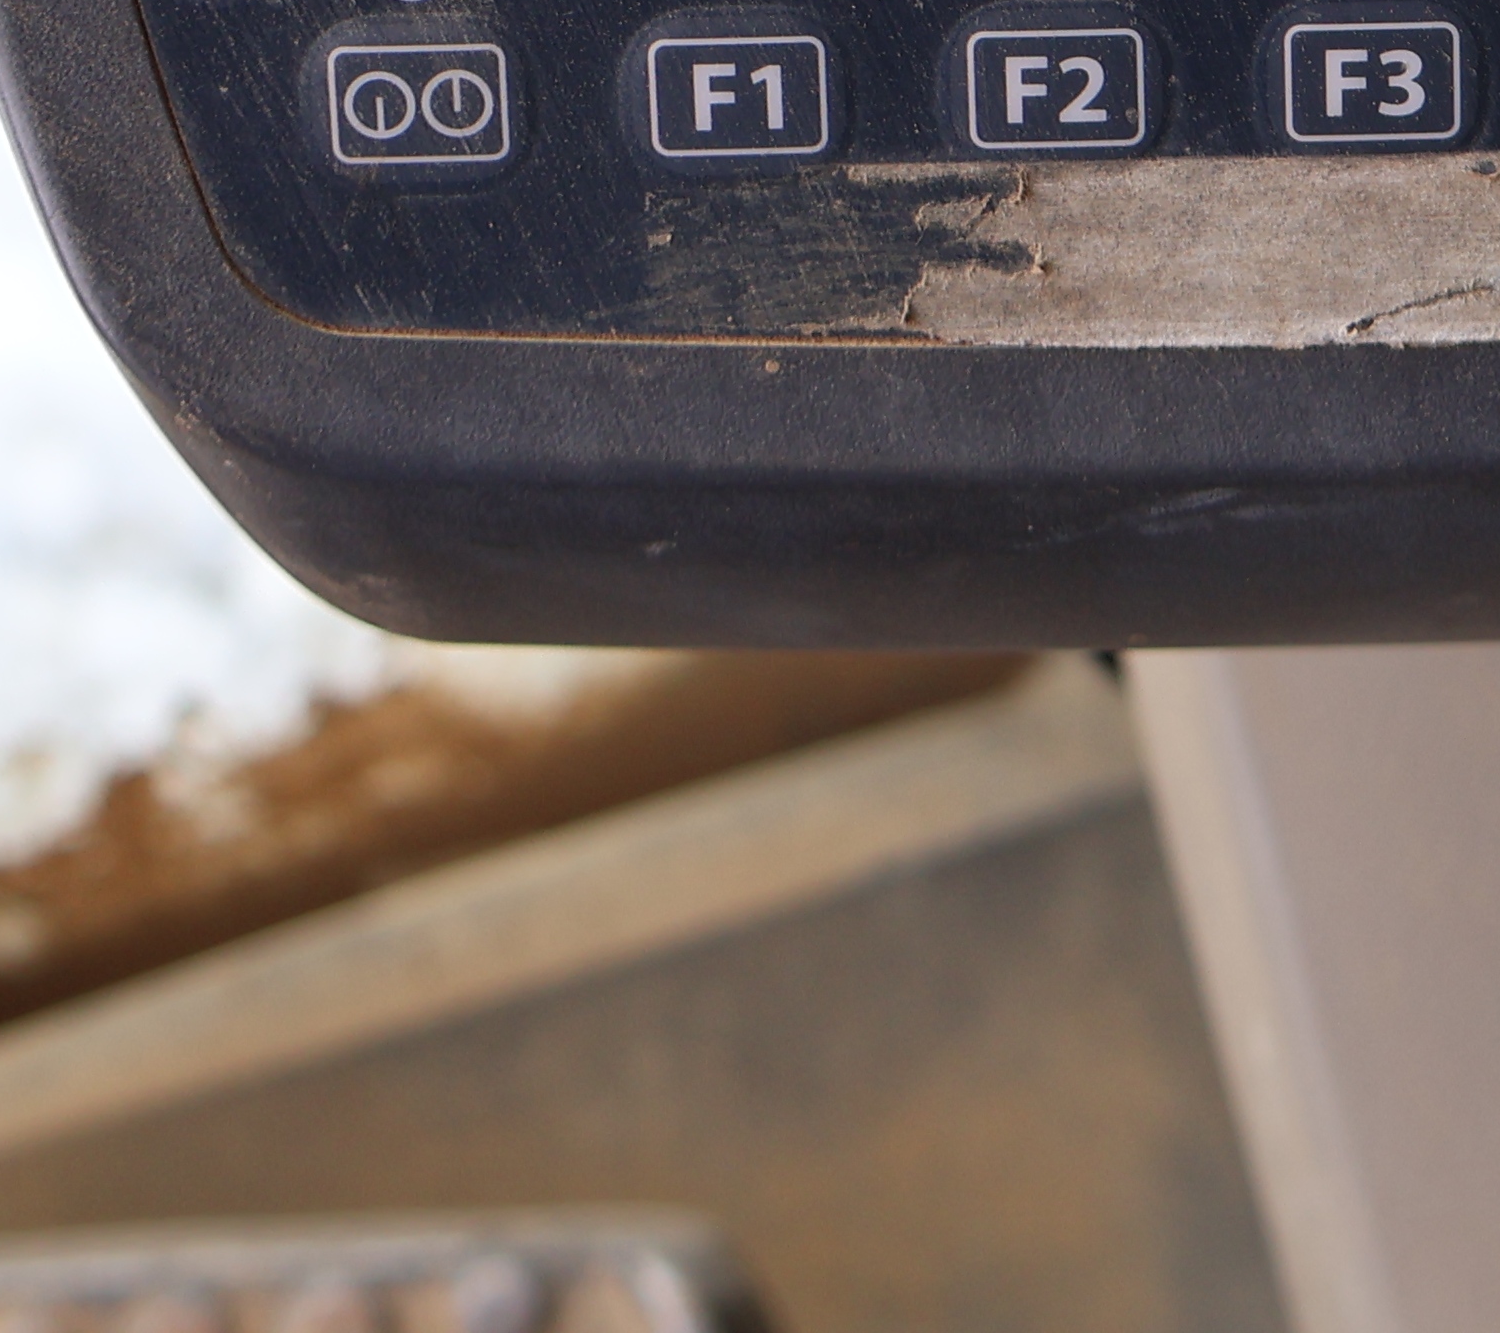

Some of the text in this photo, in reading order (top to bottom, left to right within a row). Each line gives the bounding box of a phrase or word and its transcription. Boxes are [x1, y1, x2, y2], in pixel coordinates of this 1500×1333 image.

[692, 64, 787, 131] F1
[1004, 55, 1108, 124] F2
[1324, 49, 1425, 117] F3
